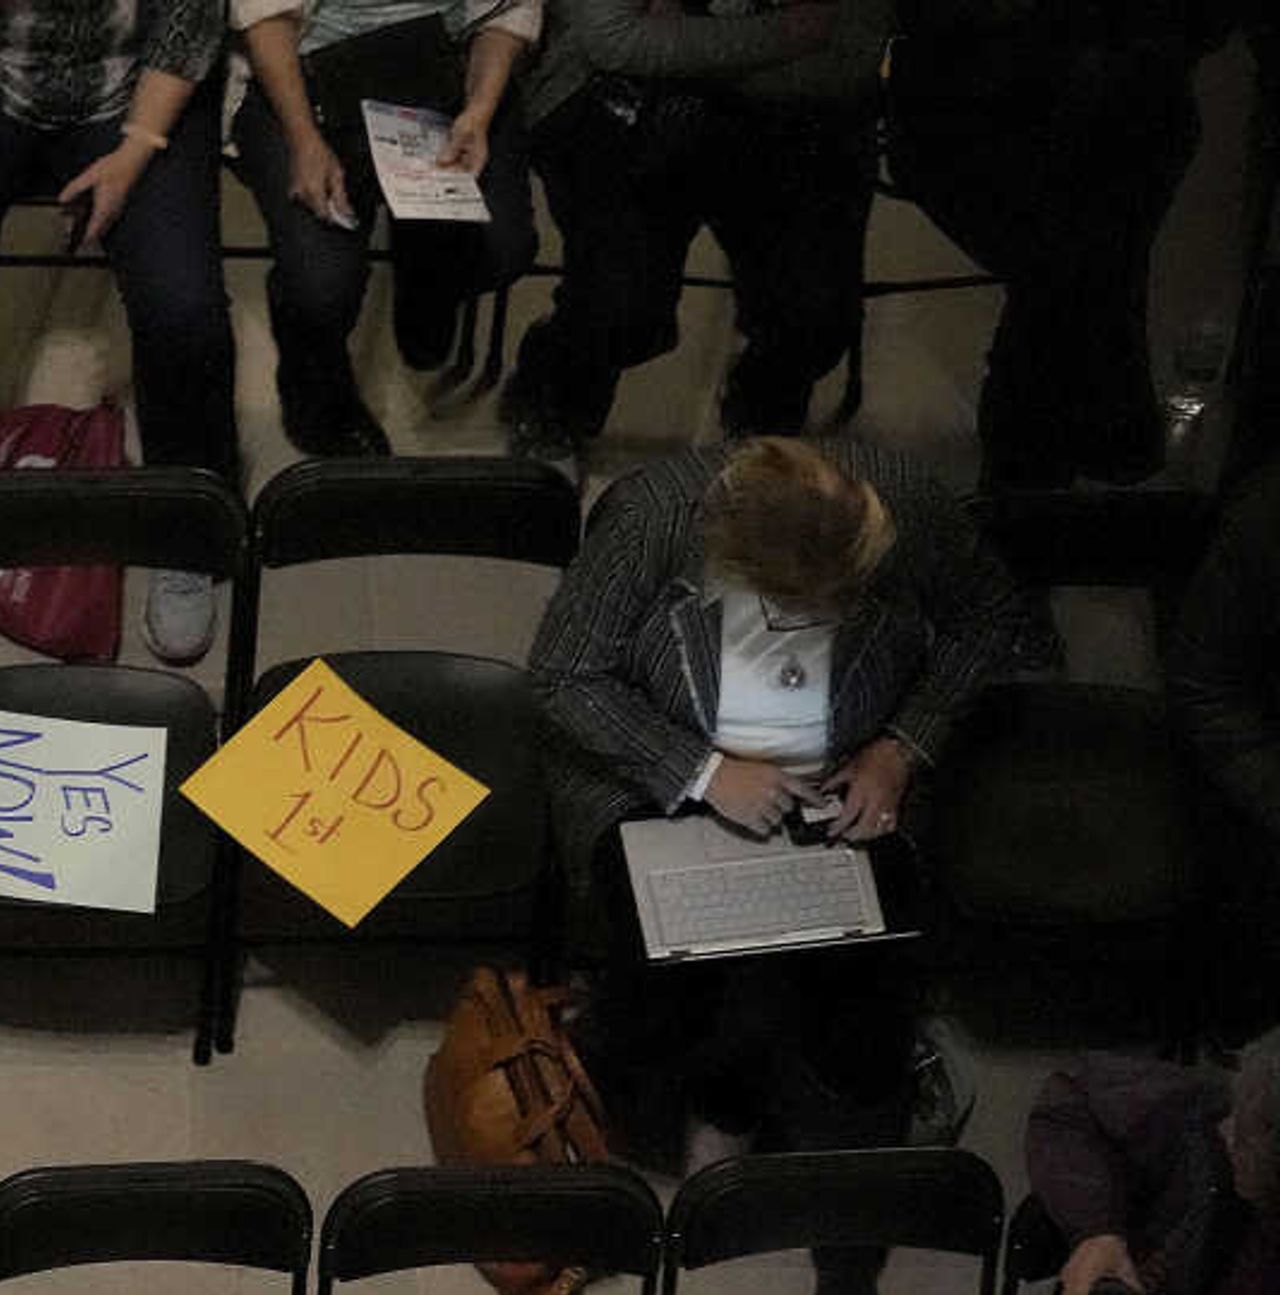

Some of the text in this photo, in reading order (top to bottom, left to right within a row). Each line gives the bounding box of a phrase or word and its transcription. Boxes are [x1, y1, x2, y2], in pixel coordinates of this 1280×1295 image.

[32, 753, 149, 839] YES
[273, 686, 447, 832] KIDS
[266, 791, 344, 854] 1st
